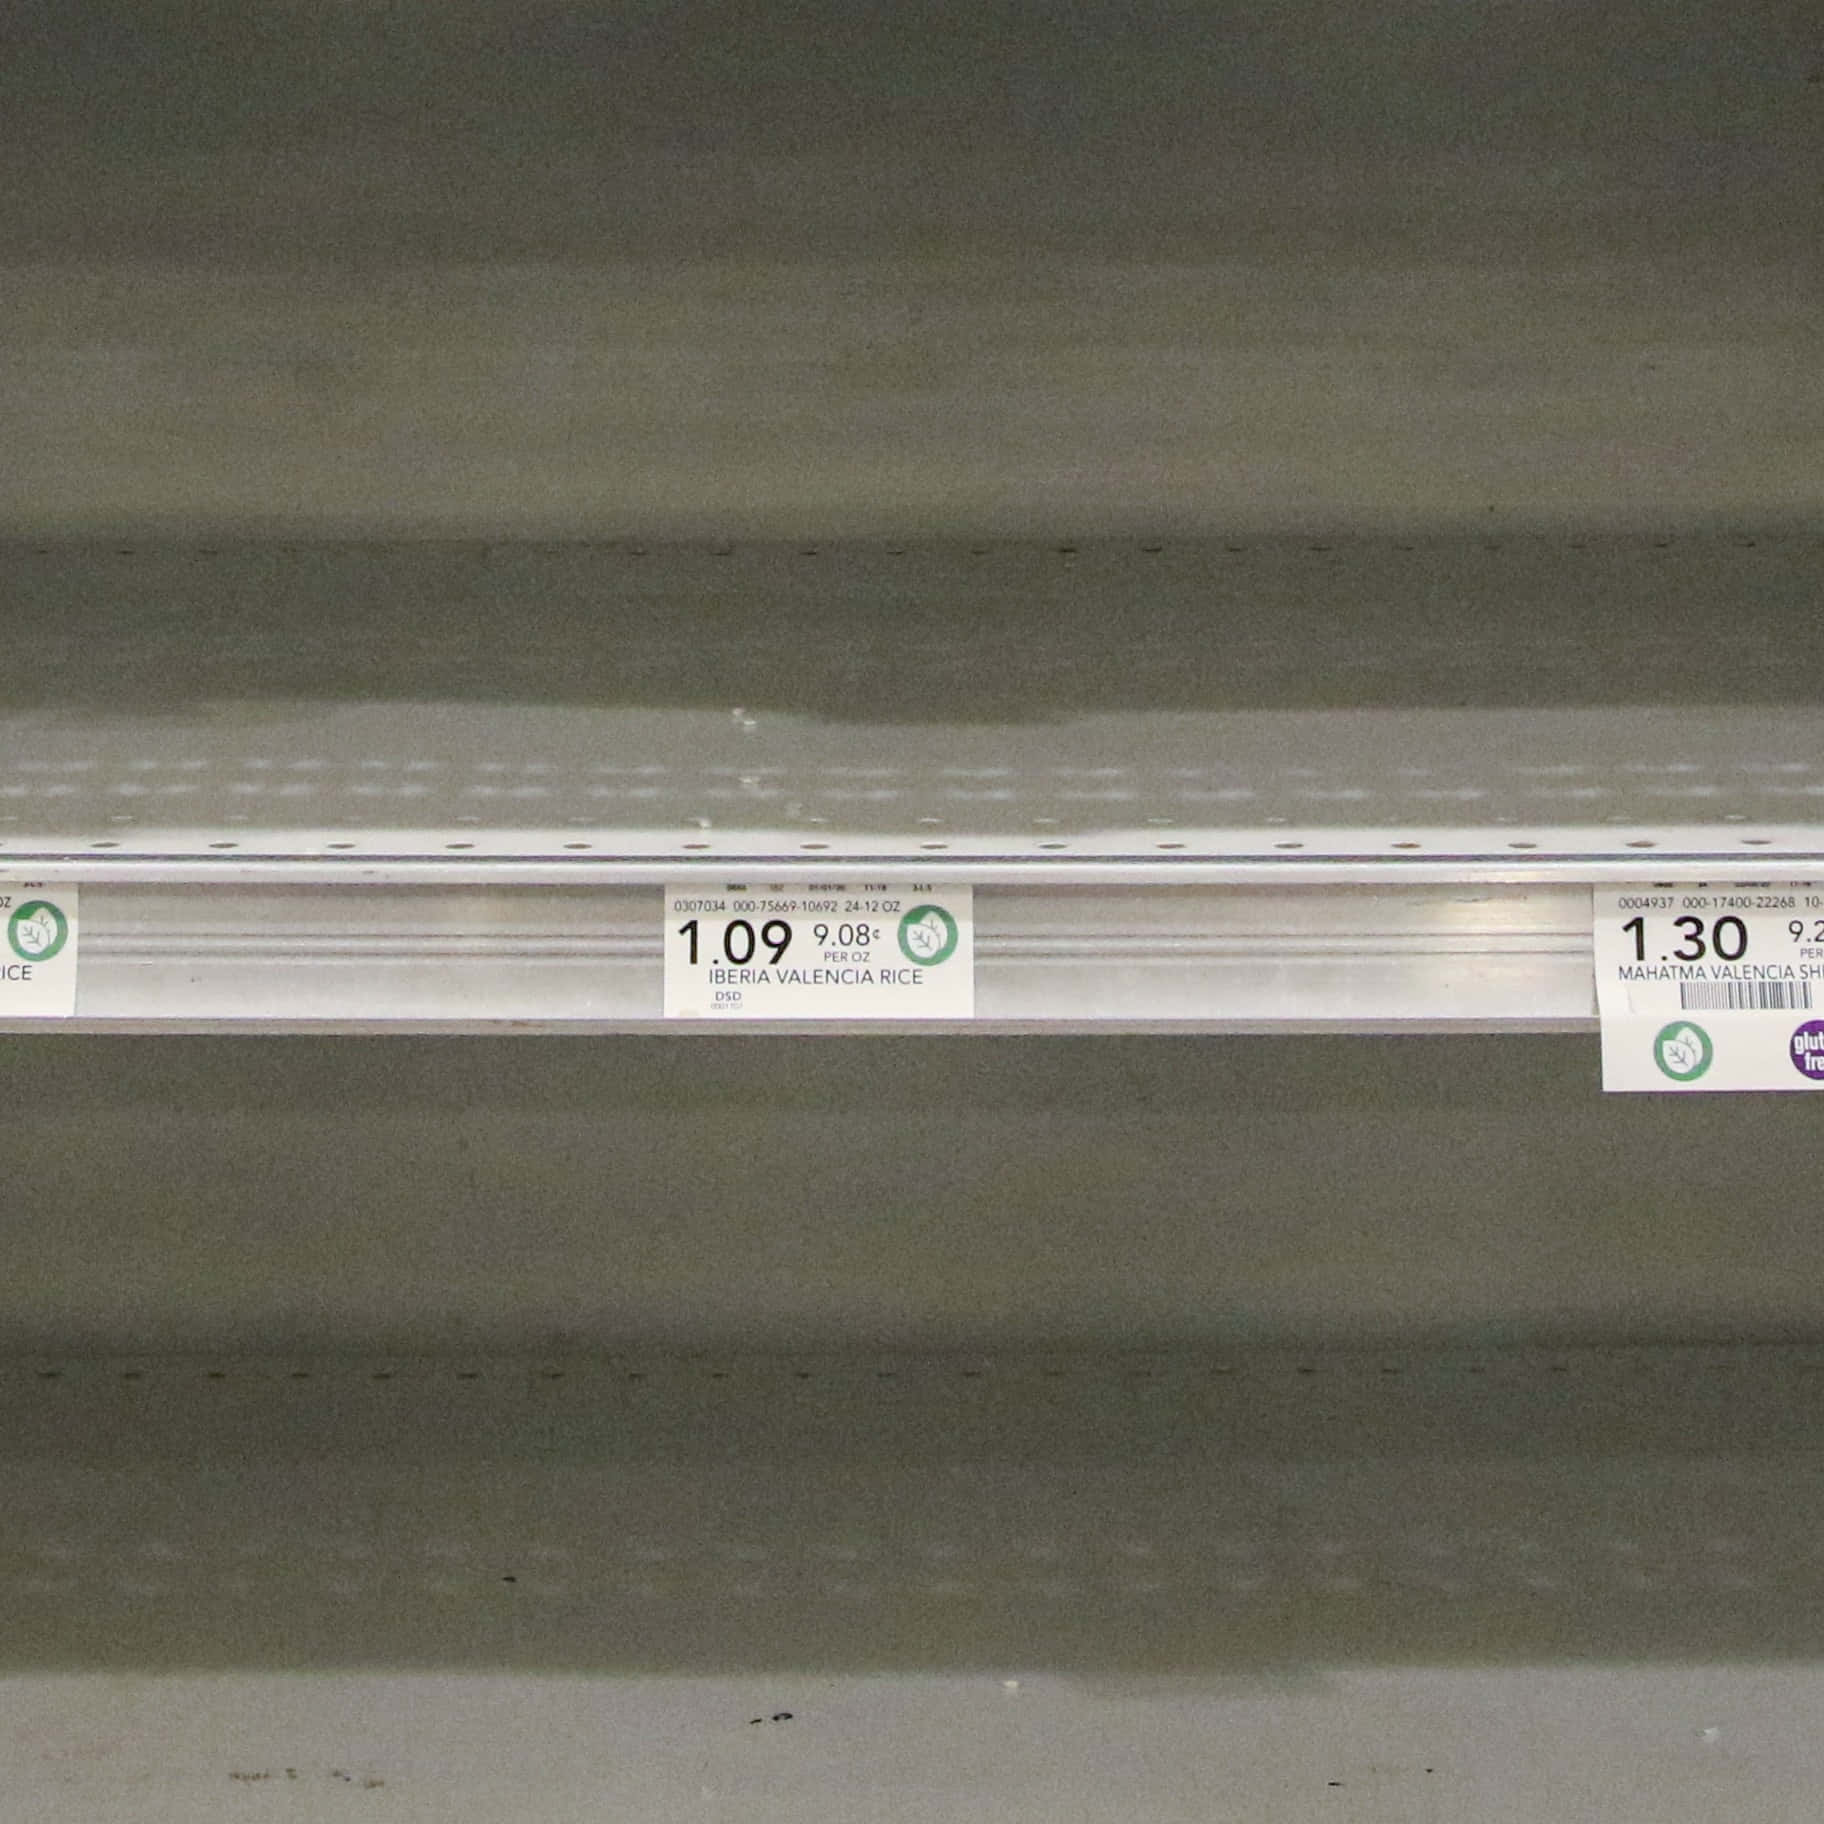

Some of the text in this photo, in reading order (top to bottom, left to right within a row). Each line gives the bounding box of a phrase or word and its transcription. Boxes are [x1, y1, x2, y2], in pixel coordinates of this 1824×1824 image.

[679, 919, 793, 965] 1.09
[813, 924, 880, 946] 9.08¢
[1621, 915, 1748, 962] 1.30
[709, 969, 924, 985] IBERIA VALENCIA RICE
[1618, 966, 1706, 981] MAHATMA
[1711, 965, 1794, 980] VALENCIA
